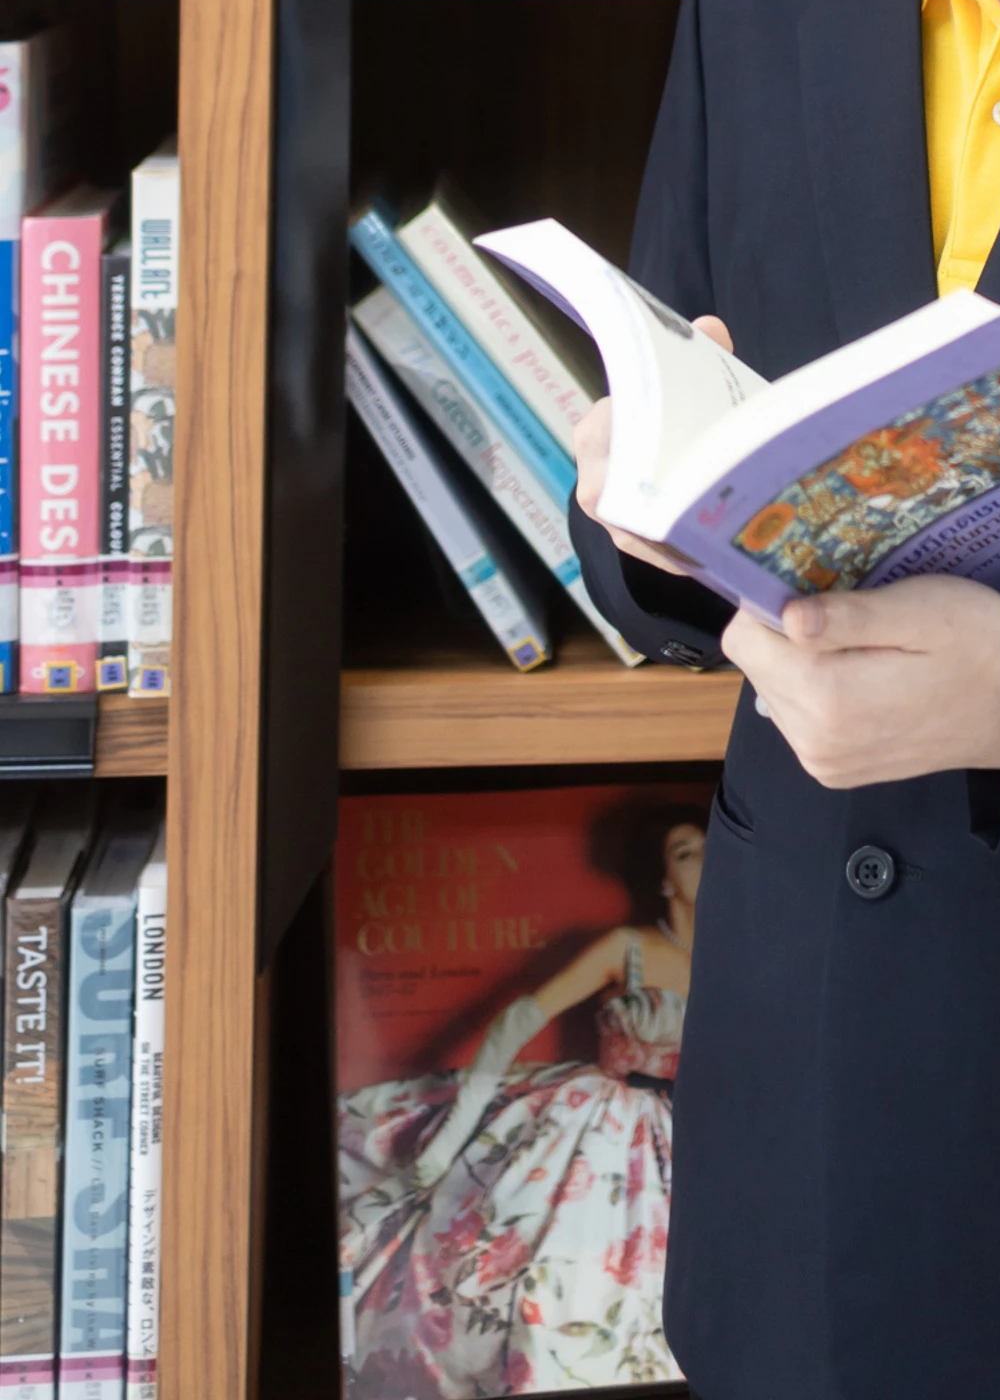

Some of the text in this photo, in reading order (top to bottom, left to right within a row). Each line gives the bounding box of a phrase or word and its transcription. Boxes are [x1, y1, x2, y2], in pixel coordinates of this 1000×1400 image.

[111, 274, 124, 342] TERENCE
[39, 240, 80, 553] CHINESE DES
[111, 345, 124, 407] CONRAN
[515, 350, 589, 428] packa
[429, 378, 488, 448] Green
[109, 415, 124, 492] ESSENTIAL
[357, 844, 521, 881] GOLDEN
[355, 884, 429, 920] AGE
[357, 914, 547, 957] COUTURE
[142, 913, 167, 1001] LONDON
[14, 927, 47, 1085] TASTE IT!
[139, 1058, 150, 1076] THE
[139, 1080, 150, 1115] STREET
[151, 1051, 163, 1145] BEAUTIFUL DESIGNS
[70, 910, 136, 1353] SURF SHA
[91, 1097, 105, 1152] SHACK
[138, 1119, 149, 1156] CORNER
